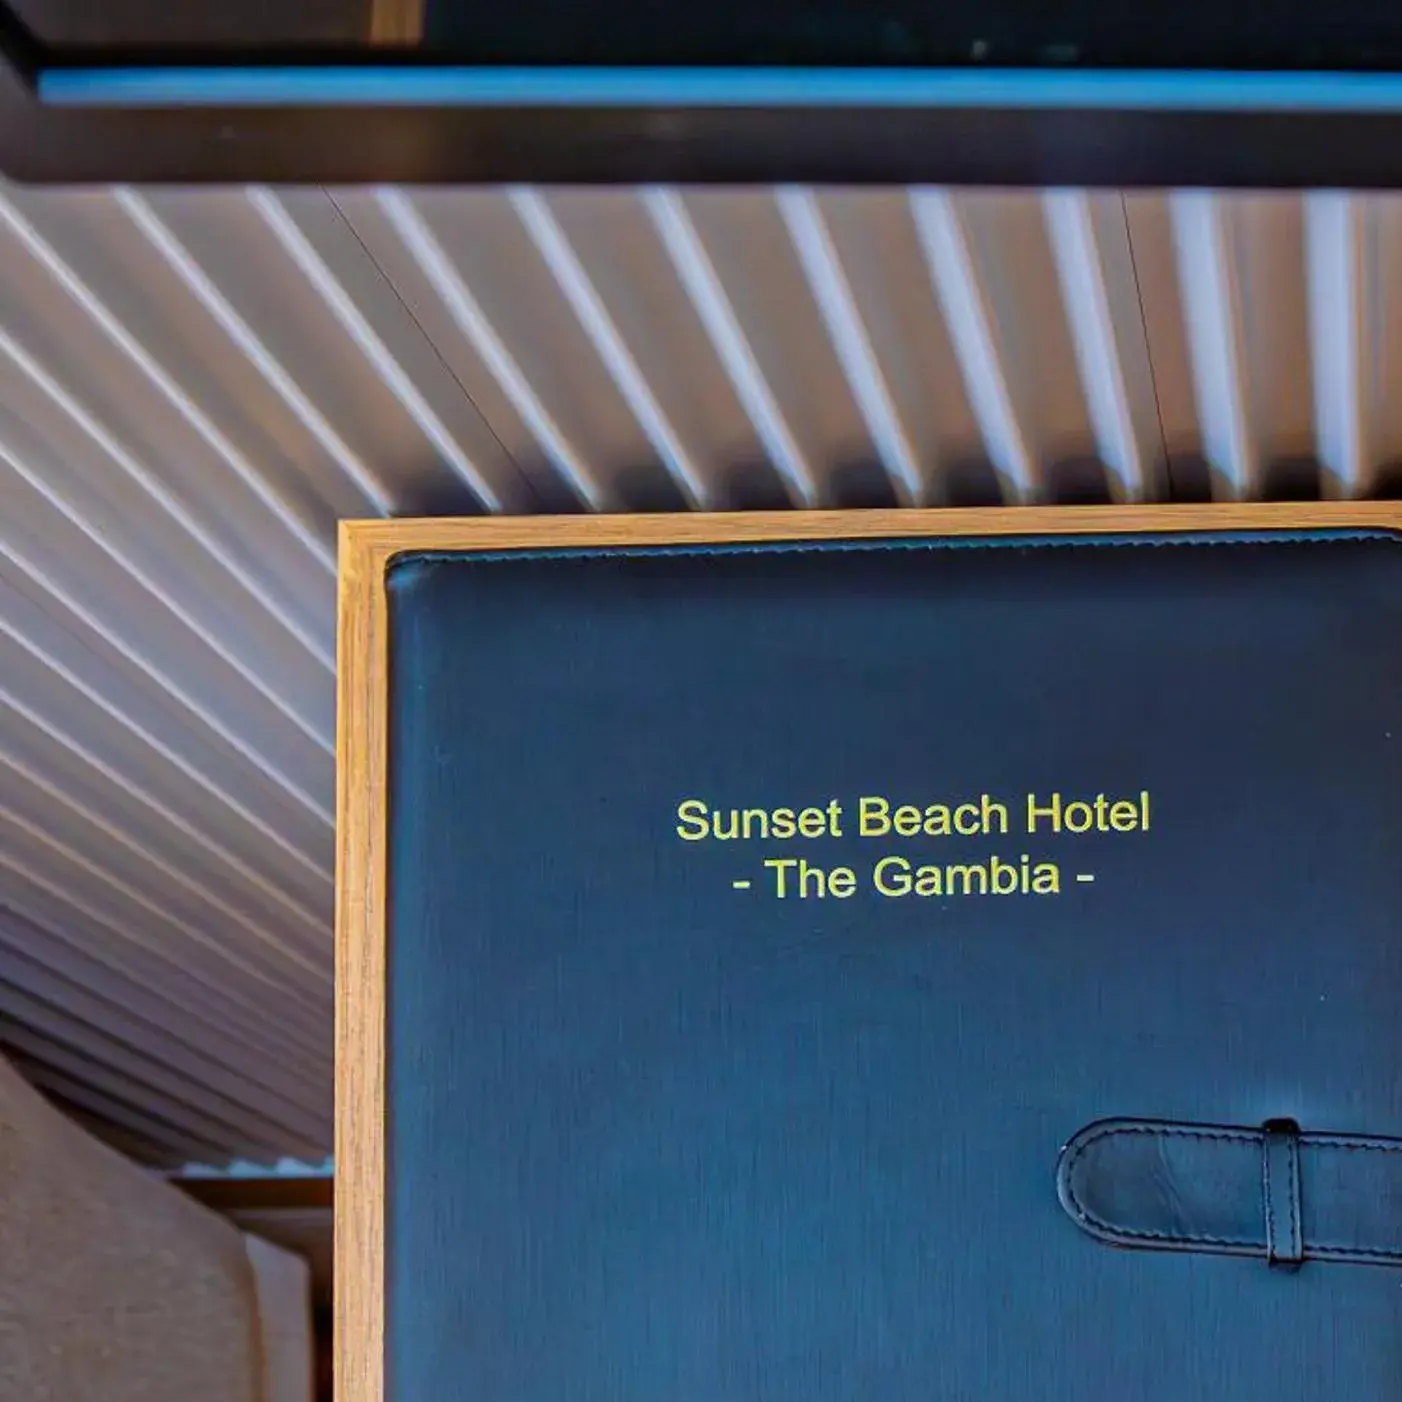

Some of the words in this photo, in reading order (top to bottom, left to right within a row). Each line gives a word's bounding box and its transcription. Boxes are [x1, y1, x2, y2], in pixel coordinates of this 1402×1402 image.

[676, 799, 843, 841] Sunset
[859, 793, 1008, 837] Beach
[1027, 790, 1150, 832] Hotel
[763, 858, 857, 898] The
[872, 854, 1060, 896] Gambia
